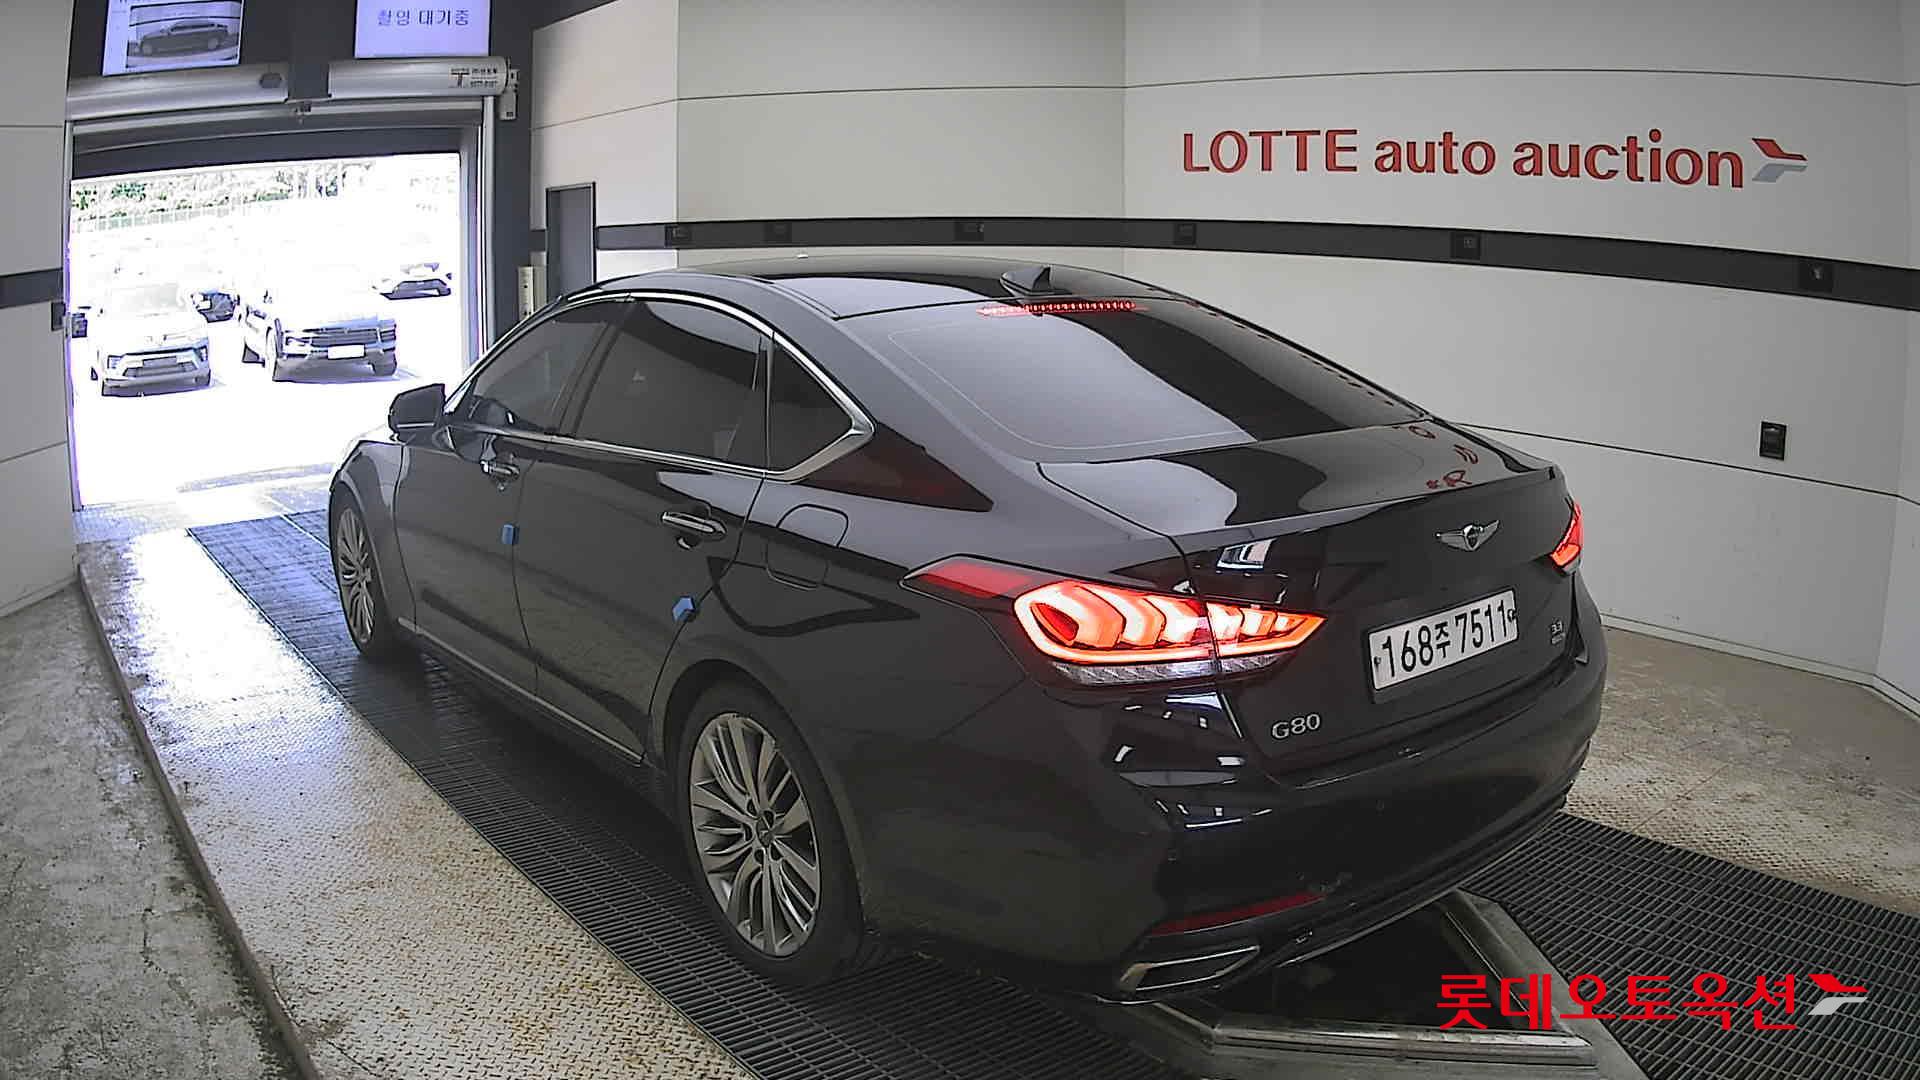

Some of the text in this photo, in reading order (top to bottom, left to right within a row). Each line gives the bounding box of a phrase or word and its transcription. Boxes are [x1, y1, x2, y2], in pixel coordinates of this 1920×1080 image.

[1183, 129, 1744, 188] LOTTE auto auction
[1271, 713, 1322, 740] G80
